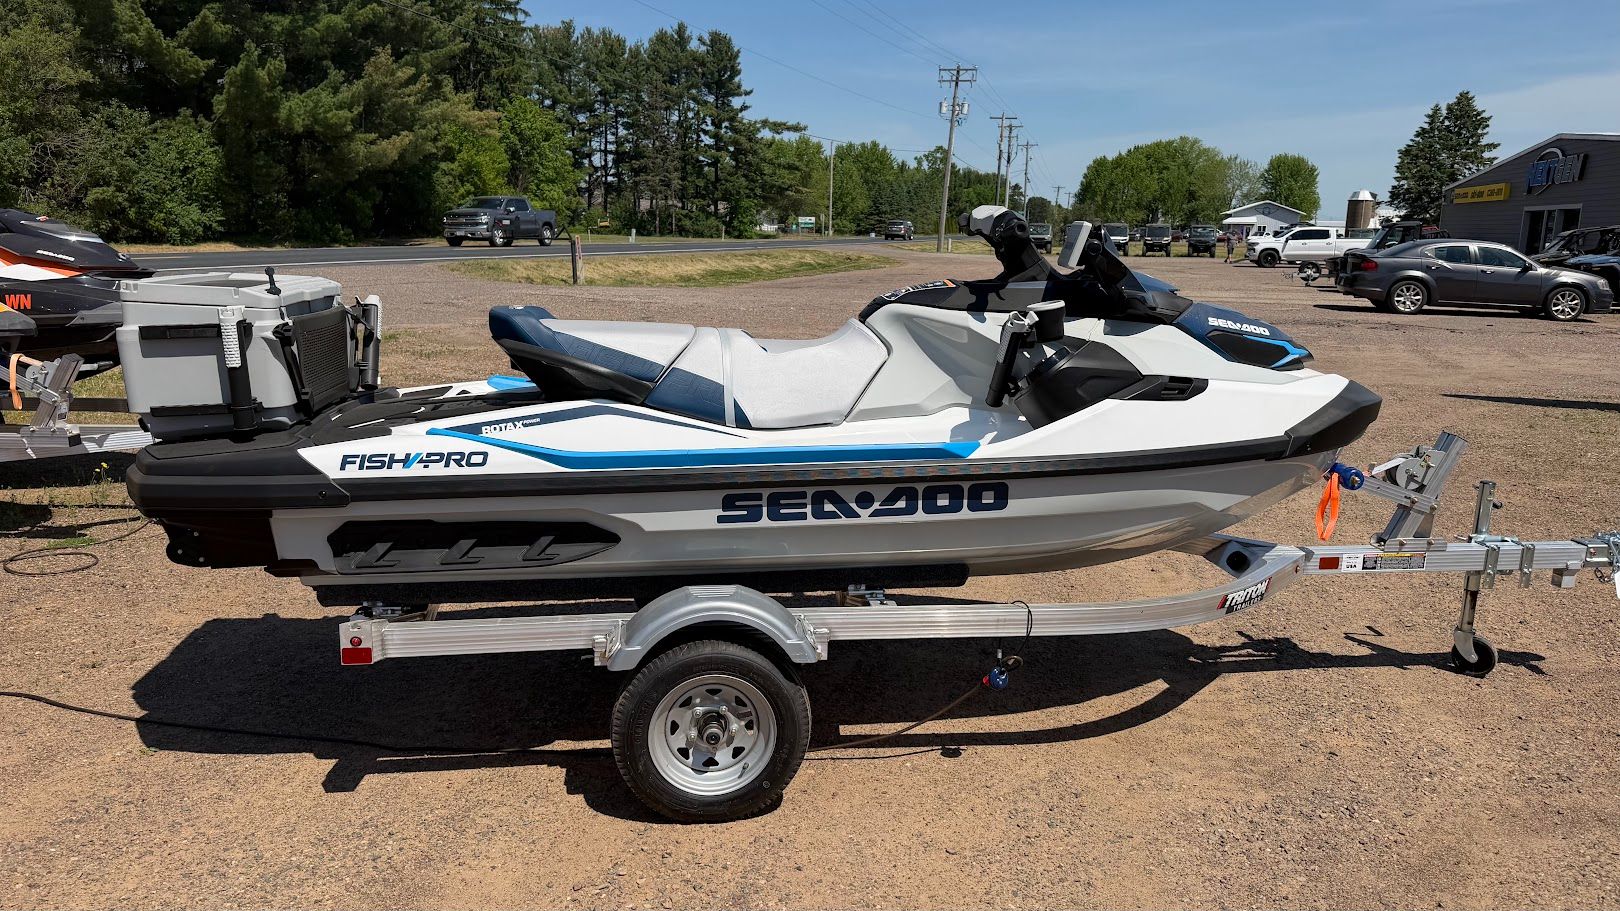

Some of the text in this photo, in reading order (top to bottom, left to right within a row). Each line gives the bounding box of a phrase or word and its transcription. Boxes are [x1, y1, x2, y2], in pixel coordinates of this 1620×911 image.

[5, 294, 32, 310] WN
[481, 420, 524, 436] ROTAX
[1225, 579, 1269, 608] TRITON
